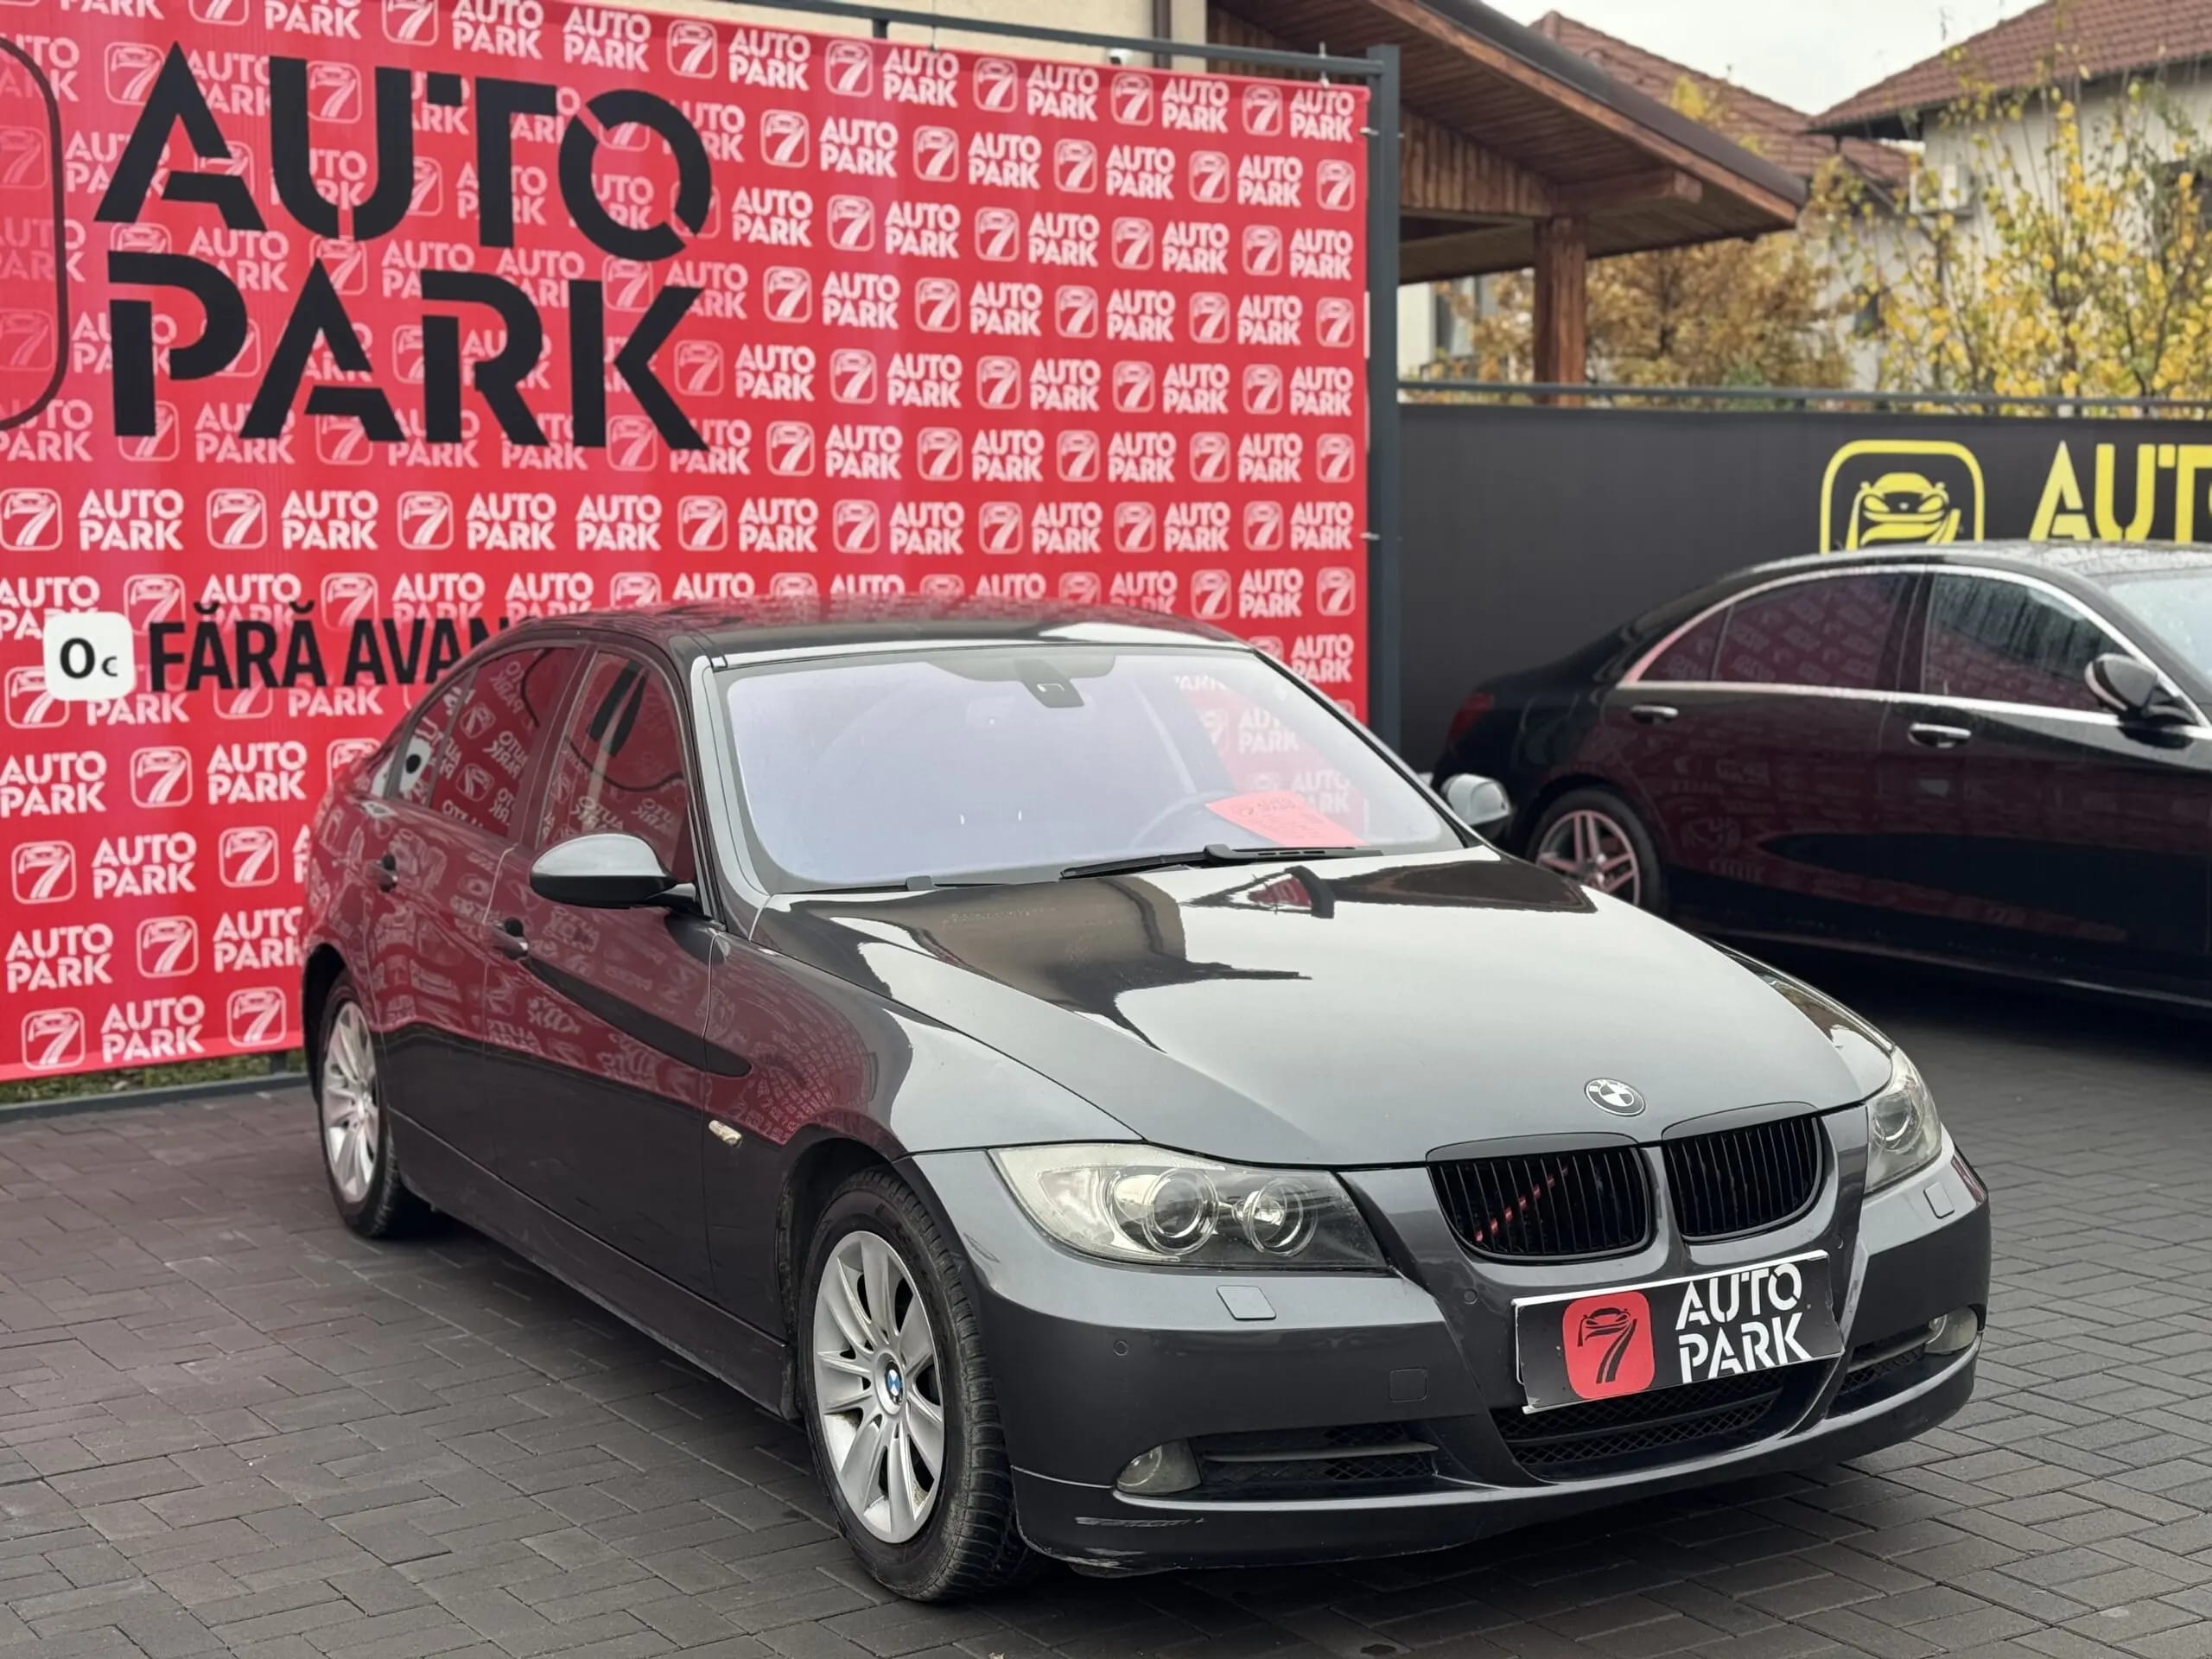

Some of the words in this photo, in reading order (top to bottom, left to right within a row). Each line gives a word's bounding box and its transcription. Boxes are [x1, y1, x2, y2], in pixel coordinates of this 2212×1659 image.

[265, 1, 361, 39] PARK
[452, 0, 543, 29] AUTO
[563, 7, 651, 42] AUTO
[453, 20, 541, 59] PARK
[565, 33, 648, 72] PARK
[728, 29, 810, 62] AUTO
[729, 54, 809, 91] PARK
[883, 48, 959, 79] AUTO
[884, 73, 957, 107] PARK
[1027, 65, 1099, 94] AUTO
[1162, 79, 1229, 107] AUTO
[1027, 88, 1097, 121] PARK
[1162, 102, 1227, 132] PARK
[1290, 90, 1355, 115] AUTO
[820, 117, 898, 149] AUTO
[1291, 112, 1352, 142] PARK
[95, 41, 712, 261] AUTO
[821, 142, 897, 177] PARK
[969, 132, 1041, 162] AUTO
[1106, 145, 1175, 174] AUTO
[969, 157, 1040, 189] PARK
[1237, 156, 1303, 181] AUTO
[1106, 169, 1173, 200] PARK
[1237, 180, 1300, 207] PARK
[732, 187, 813, 219] AUTO
[885, 201, 961, 232] AUTO
[733, 213, 811, 247] PARK
[1028, 213, 1100, 241] AUTO
[1162, 221, 1230, 248] AUTO
[188, 226, 289, 260] AUTO
[382, 240, 474, 272] AUTO
[886, 227, 959, 258] PARK
[1028, 237, 1098, 267] PARK
[1290, 228, 1353, 256] AUTO
[496, 248, 585, 279] AUTO
[1162, 246, 1227, 274] PARK
[1290, 251, 1351, 280] PARK
[664, 261, 748, 292] AUTO
[823, 272, 900, 302] AUTO
[969, 282, 1043, 309] AUTO
[1106, 289, 1175, 315] AUTO
[1237, 296, 1302, 321] AUTO
[823, 297, 899, 329] PARK
[970, 308, 1041, 336] PARK
[1107, 315, 1173, 341] PARK
[1237, 319, 1300, 345] PARK
[108, 251, 710, 450] PARK
[735, 344, 816, 373] AUTO
[887, 353, 963, 380] AUTO
[1030, 359, 1101, 385] AUTO
[1163, 364, 1230, 389] AUTO
[1290, 366, 1353, 391] AUTO
[736, 370, 814, 401] PARK
[888, 379, 961, 408] PARK
[1030, 385, 1099, 411] PARK
[1163, 388, 1228, 414] PARK
[1291, 390, 1351, 416] PARK
[195, 433, 295, 463] PARK
[825, 424, 903, 452] AUTO
[972, 429, 1044, 455] AUTO
[1108, 432, 1176, 457] AUTO
[1237, 433, 1302, 458] AUTO
[389, 439, 479, 467] PARK
[501, 440, 588, 469] PARK
[670, 445, 750, 474] PARK
[826, 451, 901, 480] PARK
[972, 454, 1043, 481] PARK
[1109, 456, 1174, 482] PARK
[1238, 457, 1301, 482] PARK
[79, 489, 184, 519] AUTO
[282, 490, 378, 521] AUTO
[2029, 440, 2212, 543] AUT
[466, 493, 556, 521] AUTO
[576, 494, 662, 523] AUTO
[738, 498, 818, 525] AUTO
[889, 502, 964, 528] AUTO
[1032, 502, 1103, 528] AUTO
[1164, 502, 1230, 527] AUTO
[1291, 502, 1354, 526] AUTO
[79, 518, 183, 550] PARK
[283, 519, 378, 550] PARK
[467, 520, 556, 550] PARK
[577, 522, 661, 550] PARK
[739, 524, 817, 552] PARK
[890, 527, 963, 555] PARK
[1033, 527, 1101, 553] PARK
[1165, 525, 1229, 551] PARK
[1291, 525, 1352, 550] PARK
[0, 576, 100, 607] AUTO
[200, 573, 302, 605] AUTO
[392, 573, 486, 601] AUTO
[505, 572, 594, 601] AUTO
[673, 572, 754, 600] AUTO
[976, 574, 1046, 600] AUTO
[1110, 570, 1178, 597] AUTO
[1239, 568, 1304, 594] AUTO
[1239, 592, 1301, 618] PARK
[148, 600, 327, 692] FĂRĂ
[1291, 635, 1354, 659] AUTO
[1292, 658, 1353, 683] PARK
[87, 690, 189, 726] PARK
[289, 687, 383, 718] PARK
[0, 751, 107, 786] AUTO
[207, 741, 308, 773] AUTO
[0, 781, 106, 817] PARK
[208, 770, 306, 804] PARK
[92, 832, 197, 868] AUTO
[93, 861, 196, 899] PARK
[5, 923, 113, 962] AUTO
[7, 953, 112, 993] PARK
[101, 995, 205, 1034] AUTO
[102, 1024, 205, 1063] PARK
[1675, 1263, 1802, 1330] AUTO
[1679, 1313, 1812, 1382] PARK
